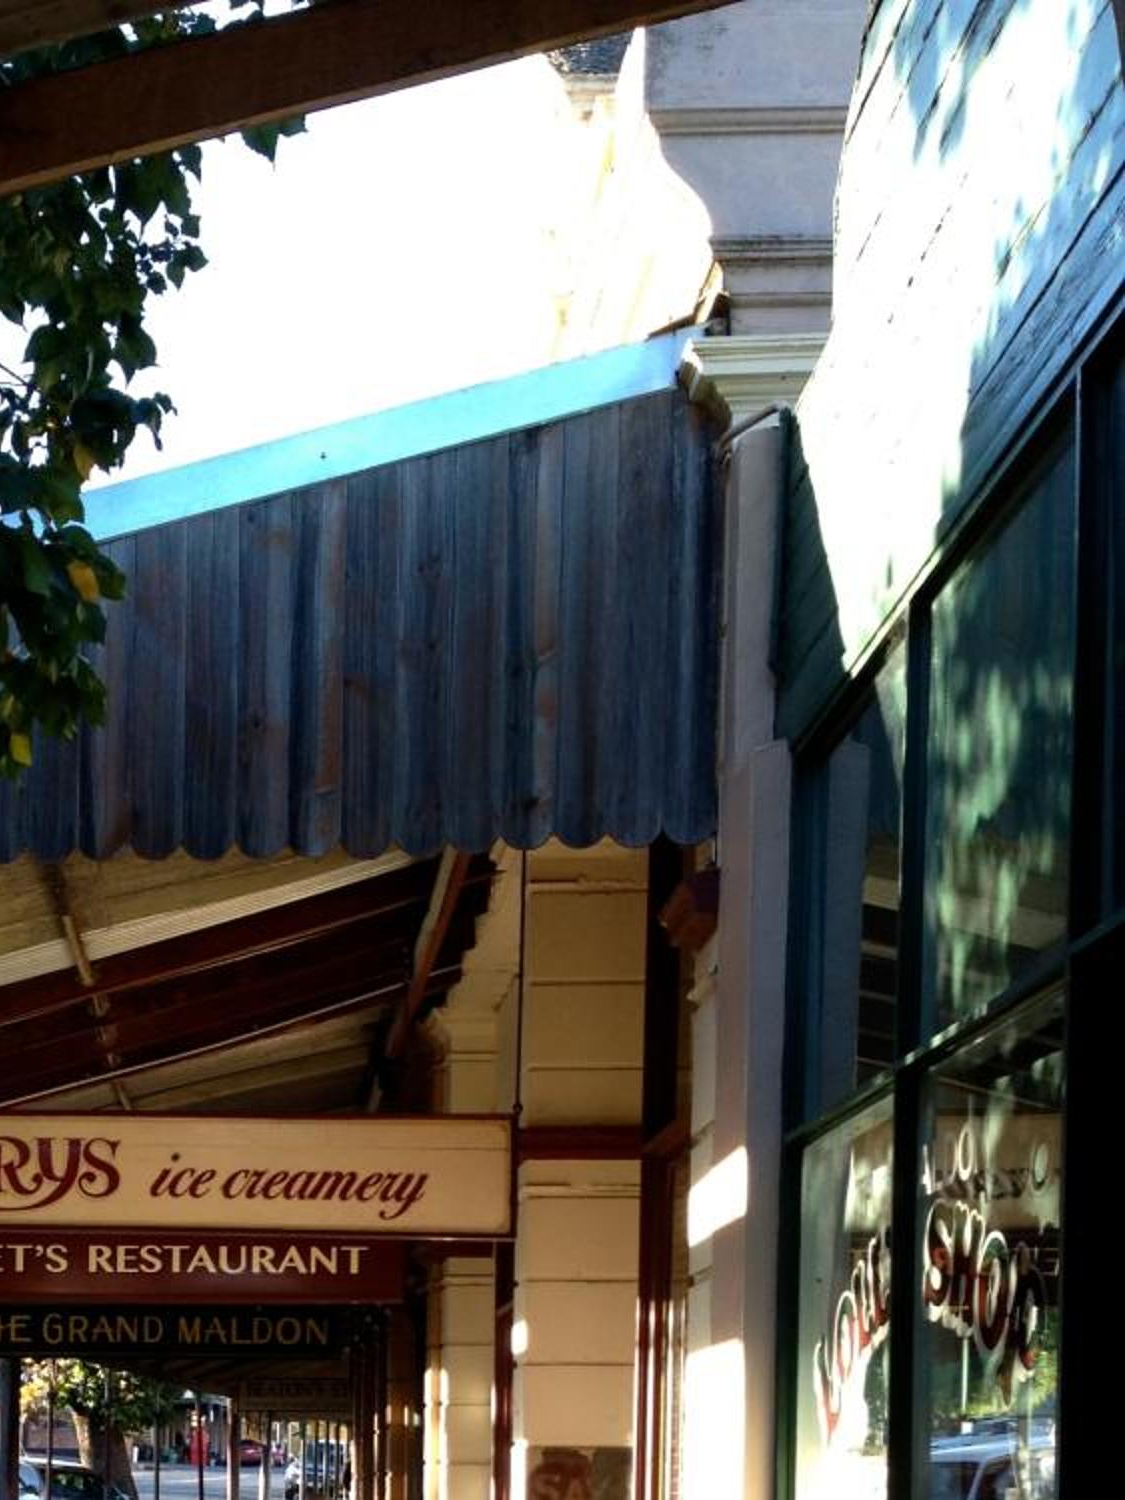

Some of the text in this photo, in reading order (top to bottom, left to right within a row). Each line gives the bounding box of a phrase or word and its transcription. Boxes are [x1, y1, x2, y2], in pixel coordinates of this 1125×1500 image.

[149, 1151, 216, 1199] ice
[220, 1158, 431, 1220] creamery
[86, 1243, 371, 1276] RESTAURANT
[42, 1312, 164, 1345] GRAND
[177, 1315, 331, 1346] MALDON
